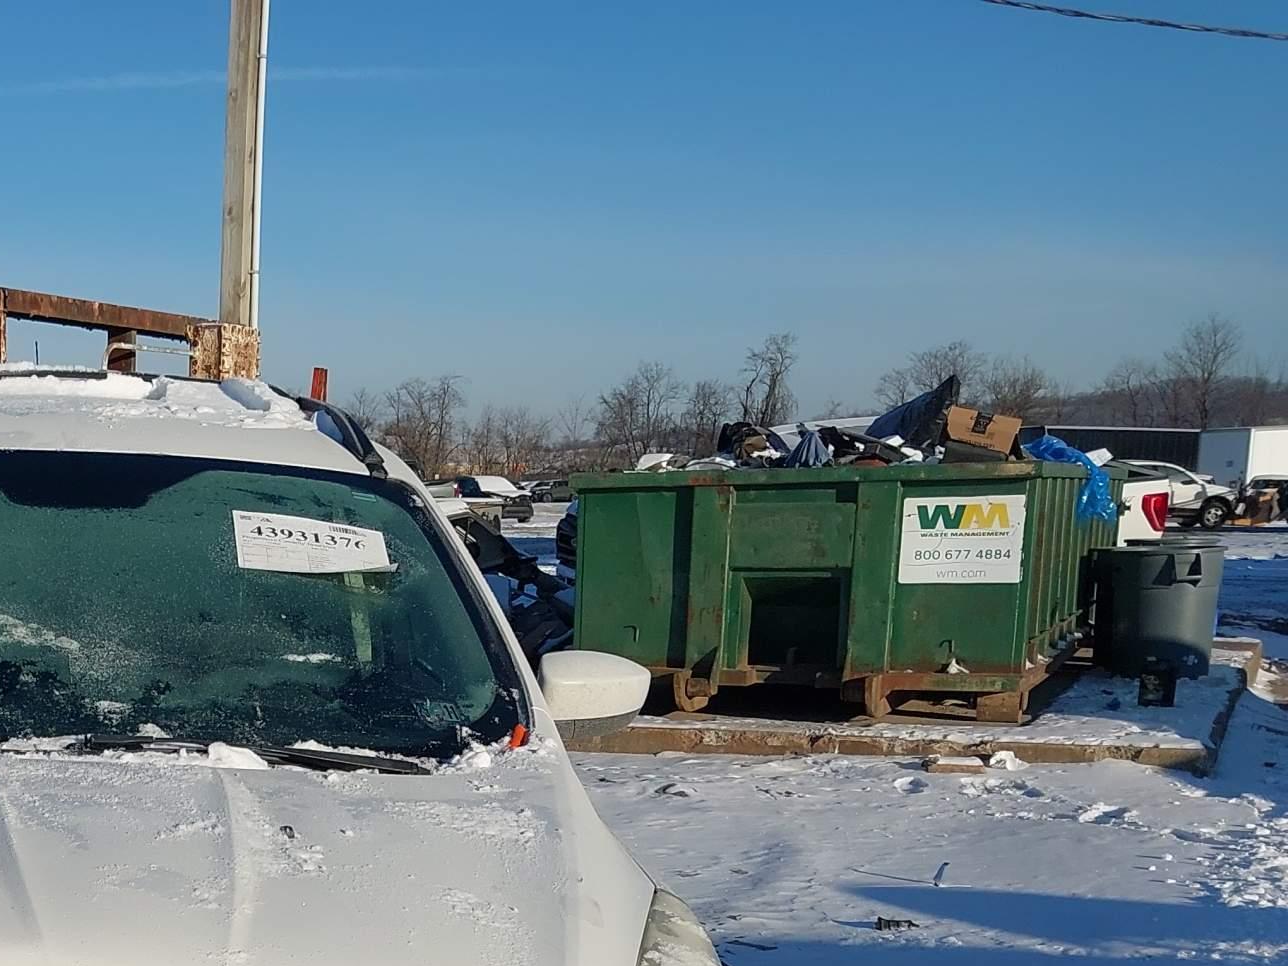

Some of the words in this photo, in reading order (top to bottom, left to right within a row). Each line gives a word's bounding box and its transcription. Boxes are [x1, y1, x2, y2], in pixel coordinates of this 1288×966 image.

[917, 503, 1010, 530] WM
[250, 524, 367, 551] 43931376
[914, 549, 941, 561] 800
[944, 549, 972, 560] 677
[975, 548, 1012, 560] 4884
